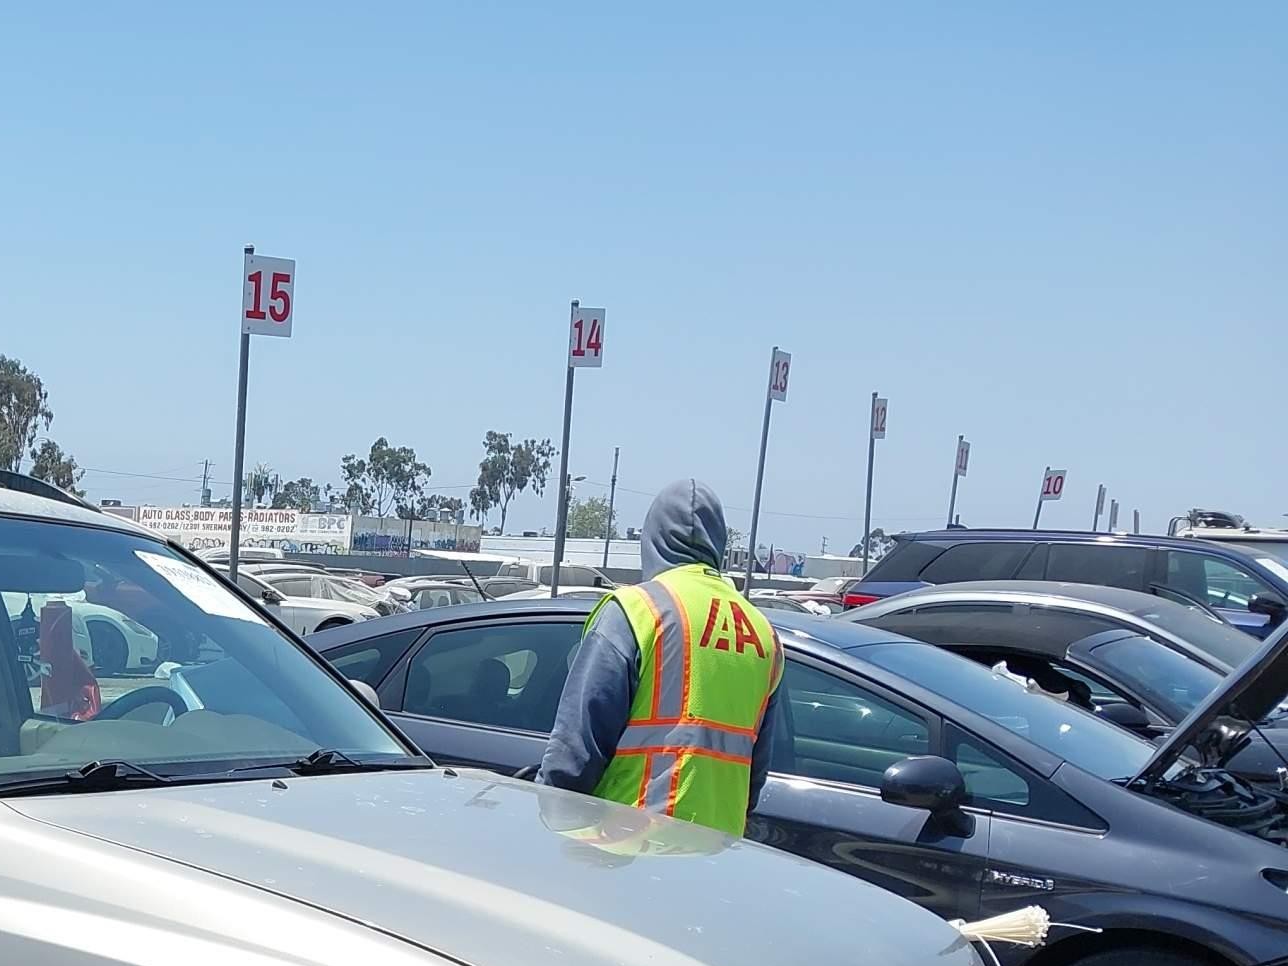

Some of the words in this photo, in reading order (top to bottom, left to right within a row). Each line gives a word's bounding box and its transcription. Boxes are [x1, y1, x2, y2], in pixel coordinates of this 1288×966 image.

[246, 271, 291, 322] 15
[573, 319, 601, 356] 14
[772, 360, 789, 392] 13
[874, 407, 887, 432] 12
[1043, 475, 1065, 495] 10
[142, 509, 163, 520] AUTO
[318, 517, 346, 530] BPC
